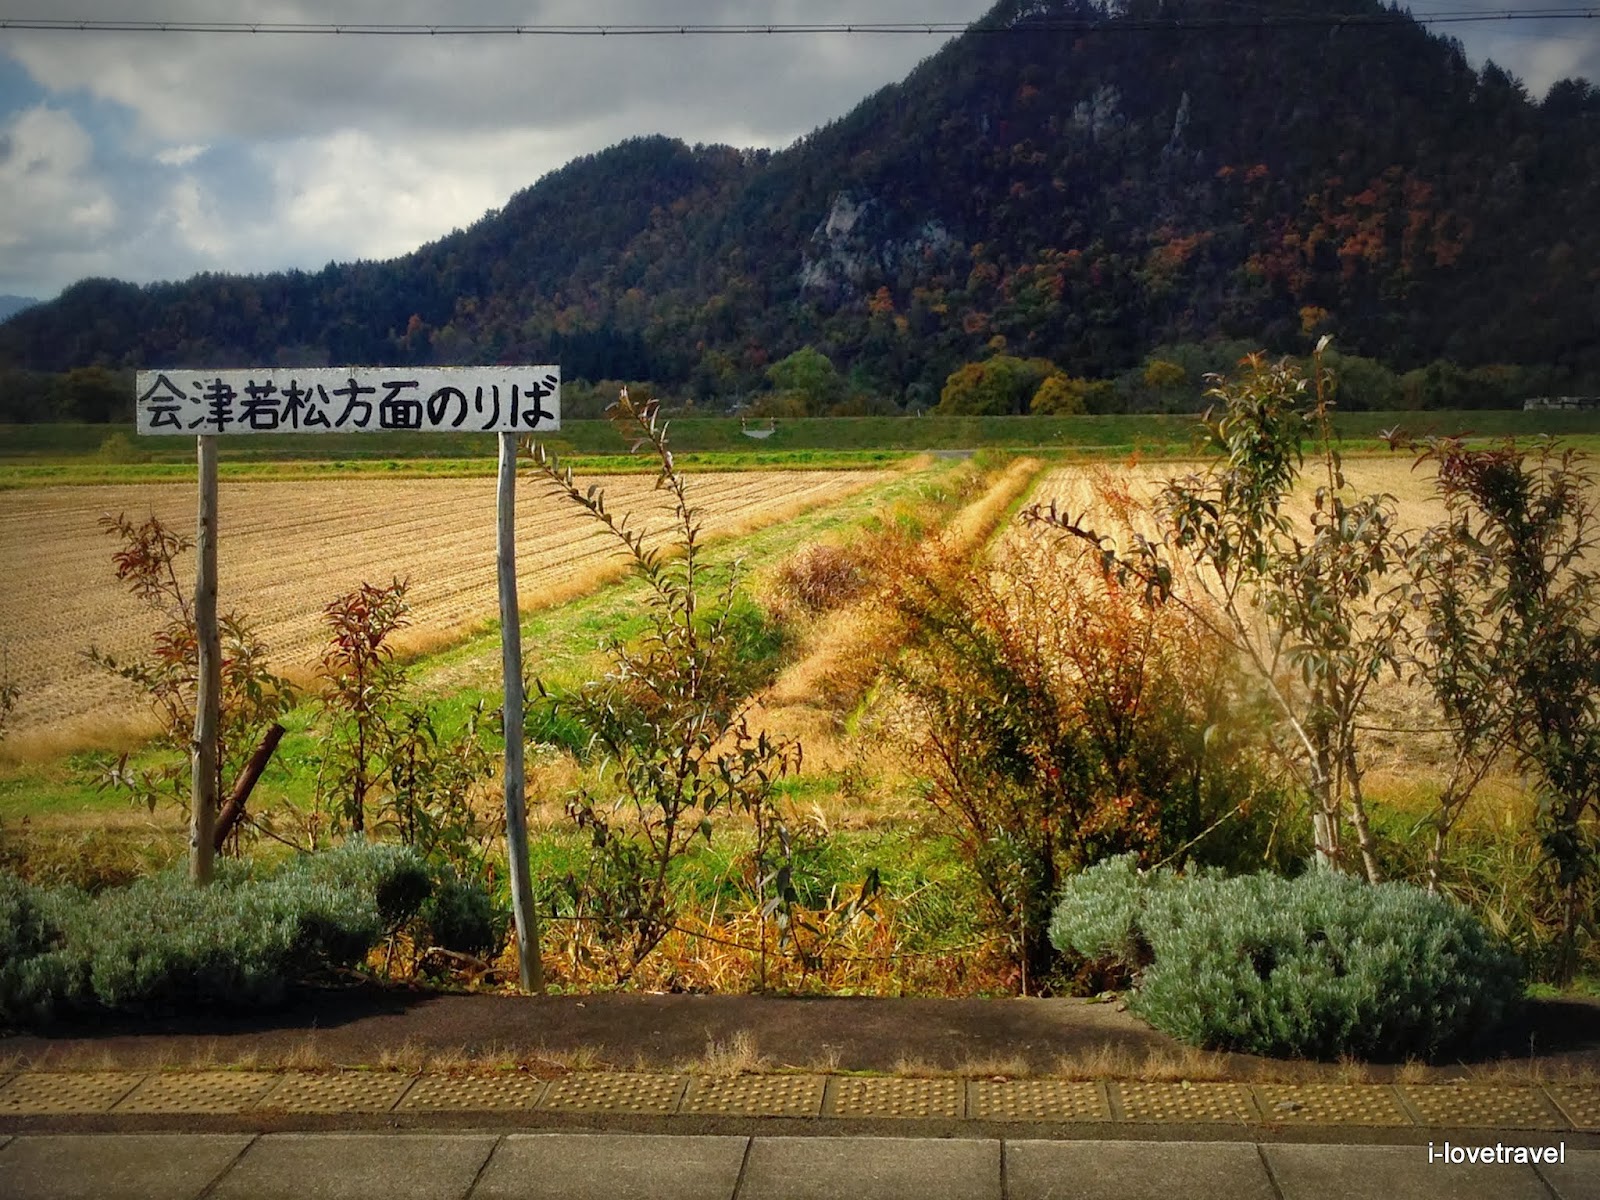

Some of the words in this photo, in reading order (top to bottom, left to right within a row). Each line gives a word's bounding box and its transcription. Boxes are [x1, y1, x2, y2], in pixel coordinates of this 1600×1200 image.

[139, 373, 558, 432] 会津若松方面のりば
